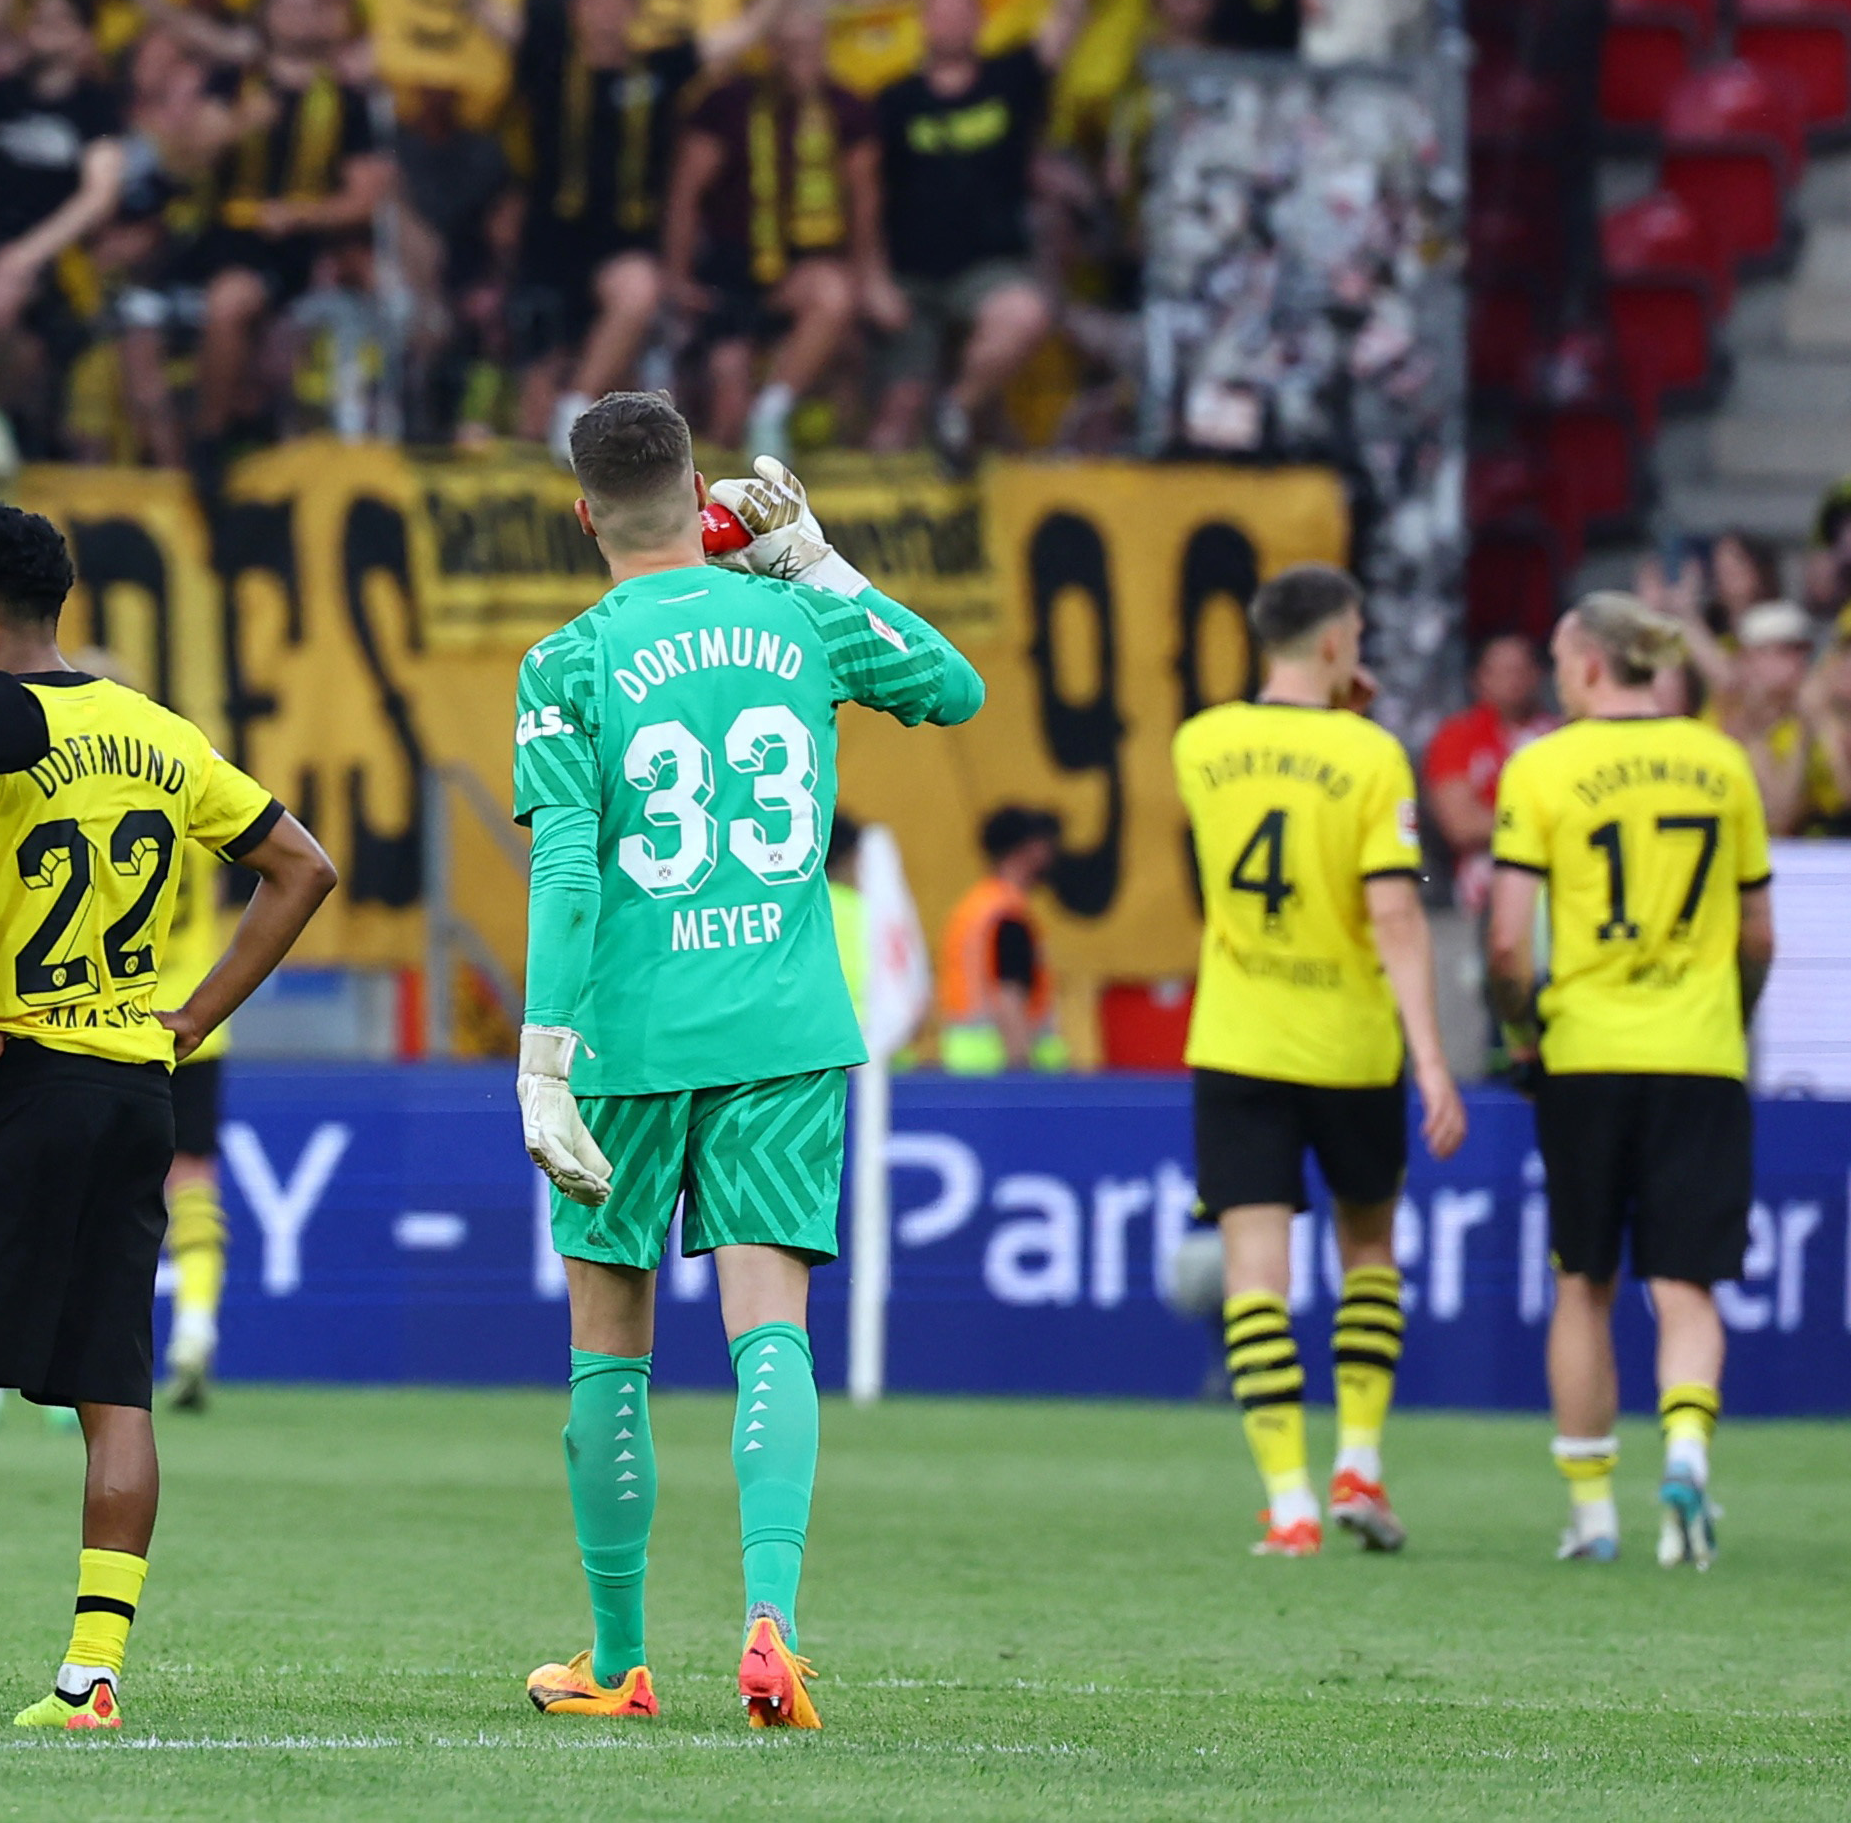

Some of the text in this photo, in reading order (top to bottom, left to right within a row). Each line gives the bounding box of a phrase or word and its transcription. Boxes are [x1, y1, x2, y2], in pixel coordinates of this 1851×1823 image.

[614, 626, 803, 704] DORTMUND
[24, 734, 186, 799] DORTMUND
[516, 705, 575, 745] GLS.
[618, 704, 822, 899] 33
[15, 809, 178, 1007] 22
[1230, 808, 1298, 935] 4
[1587, 814, 1720, 945] 17
[671, 903, 782, 951] MEYER
